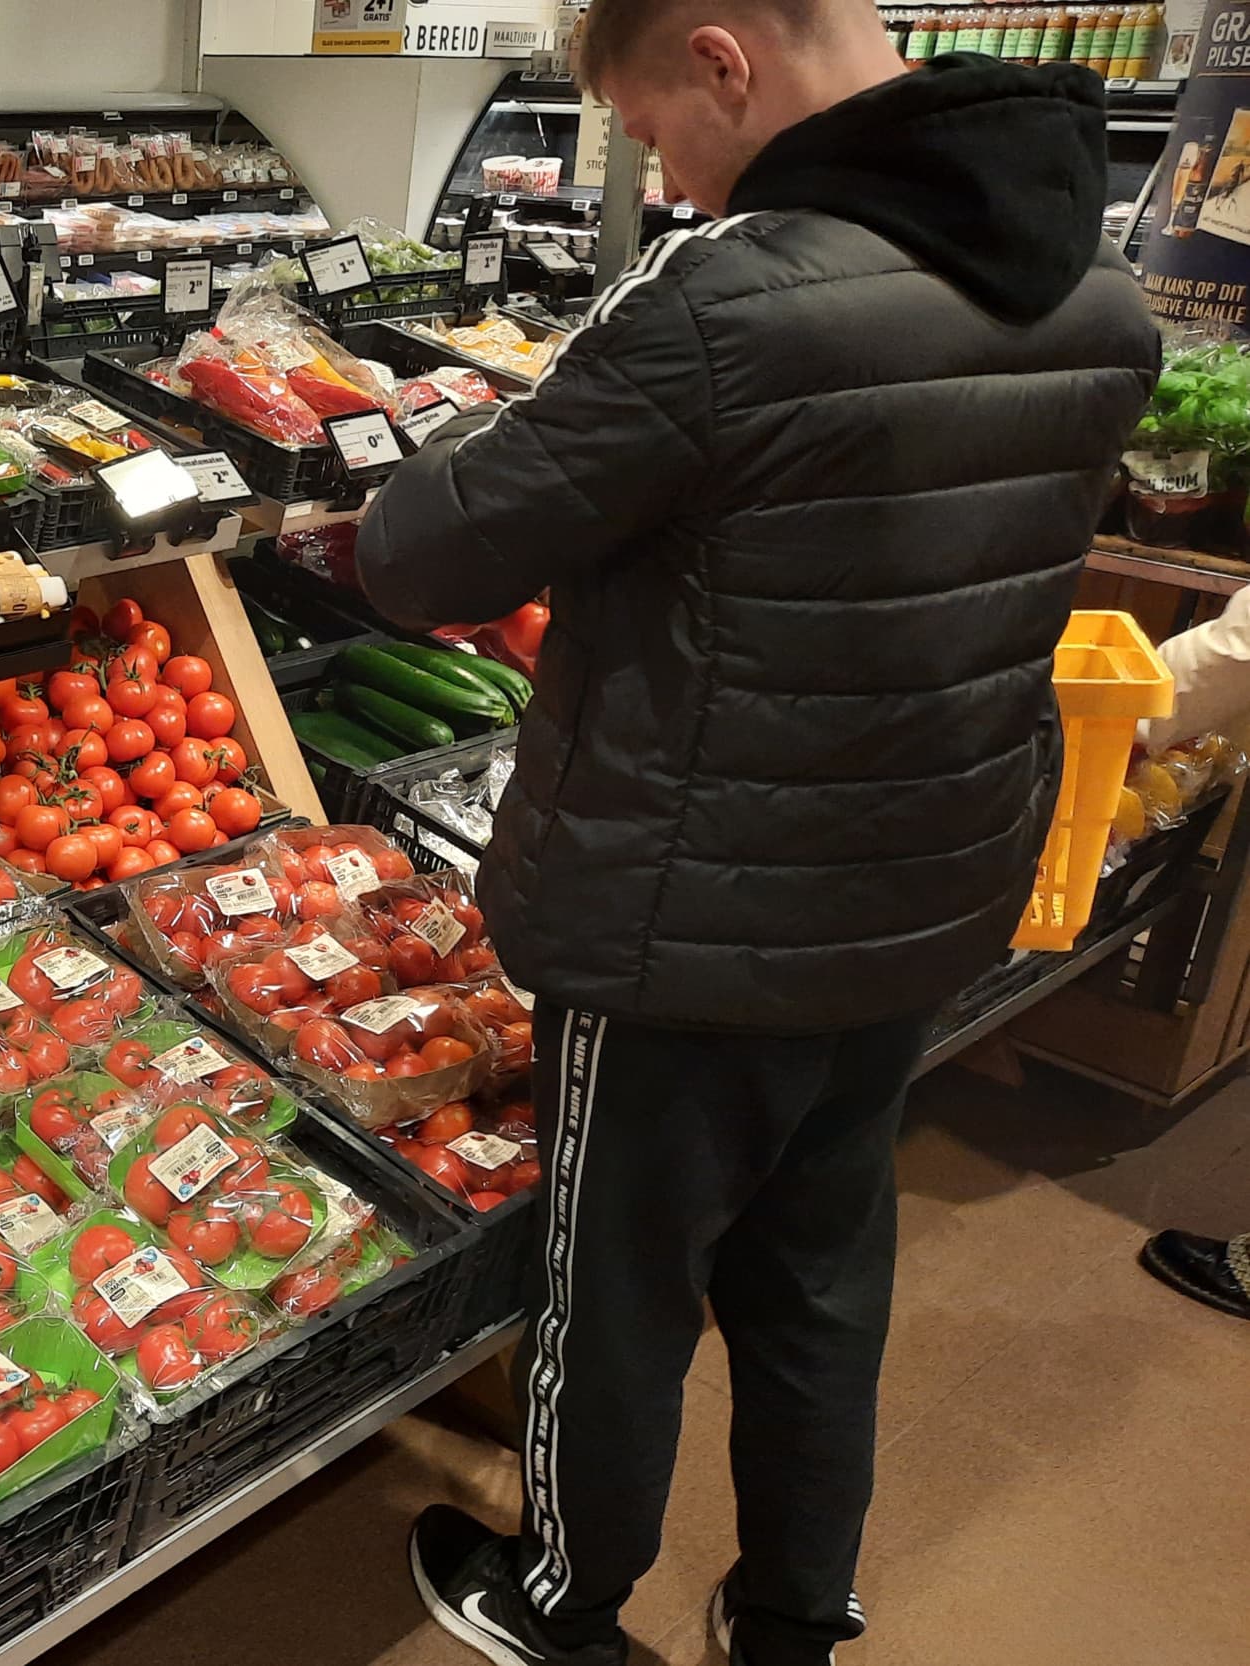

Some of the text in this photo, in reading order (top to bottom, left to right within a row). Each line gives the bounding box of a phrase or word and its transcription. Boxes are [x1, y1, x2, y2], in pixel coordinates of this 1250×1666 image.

[417, 25, 479, 51] BEREID
[494, 31, 537, 43] MAALTIJDEN
[1164, 275, 1193, 296] KANS
[1194, 281, 1216, 299] OP
[1218, 284, 1246, 302] DIT
[1184, 301, 1246, 323] EMAILLE
[572, 1034, 588, 1081] NIKE
[568, 1085, 582, 1131] NIKE
[560, 1134, 576, 1180] NIKE
